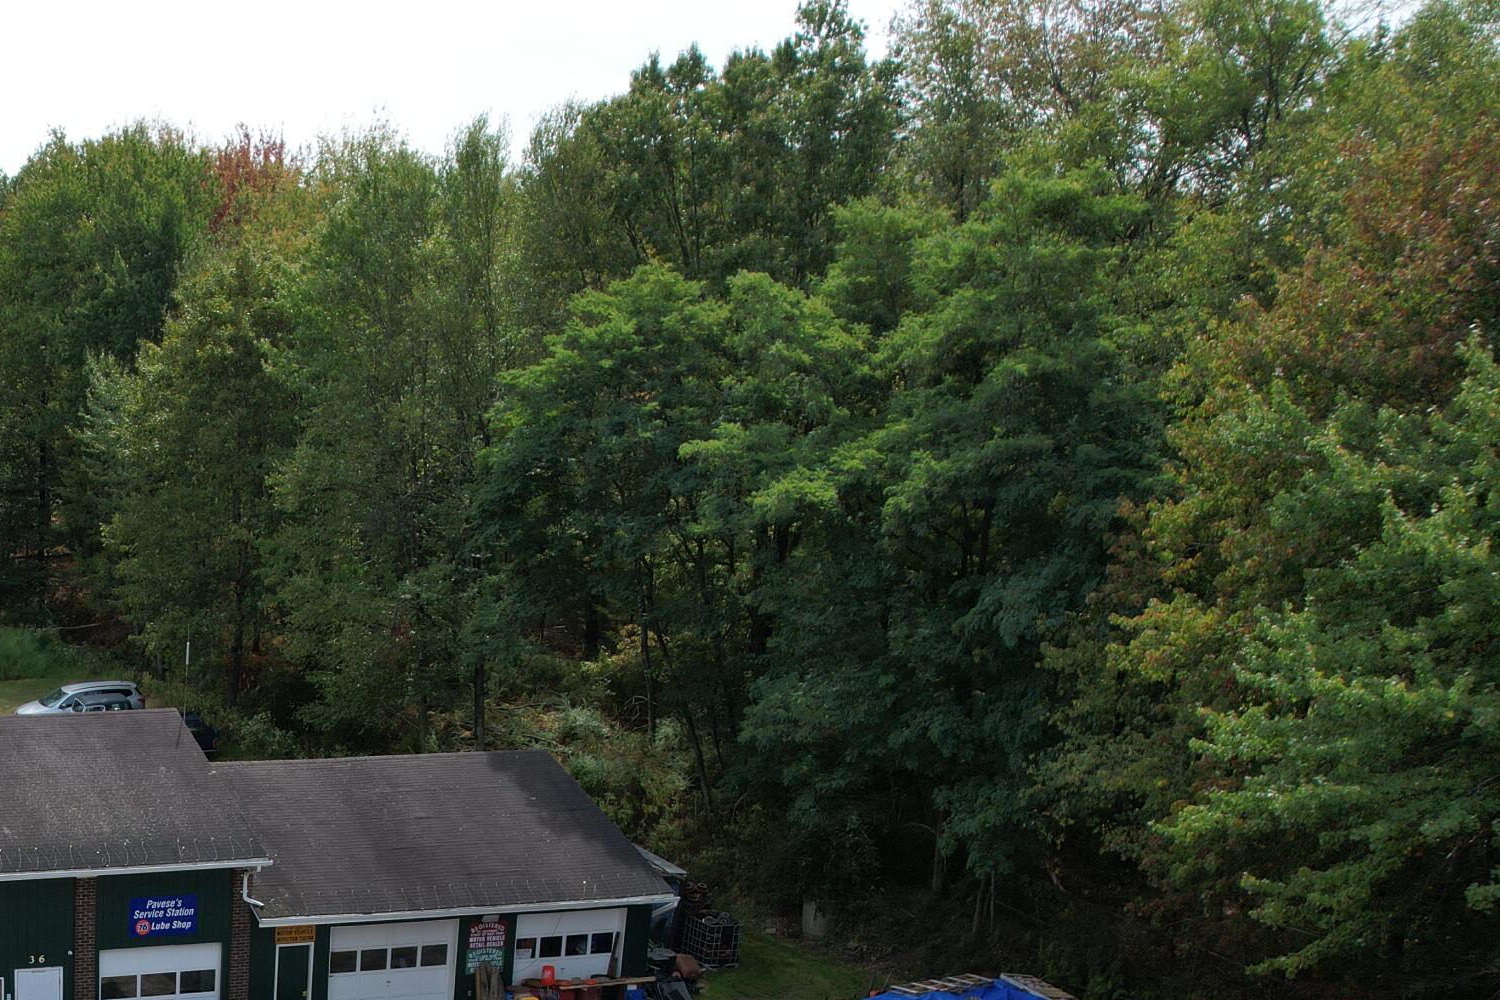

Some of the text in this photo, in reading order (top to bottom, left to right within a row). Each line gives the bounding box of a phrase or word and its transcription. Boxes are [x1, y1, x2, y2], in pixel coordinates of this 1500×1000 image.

[146, 898, 183, 909] Pavese's
[133, 907, 194, 919] Service Station
[151, 920, 192, 930] Lube Shop
[470, 922, 505, 933] REGISTERED
[468, 948, 503, 958] REGISTERED
[29, 955, 45, 964] 36
